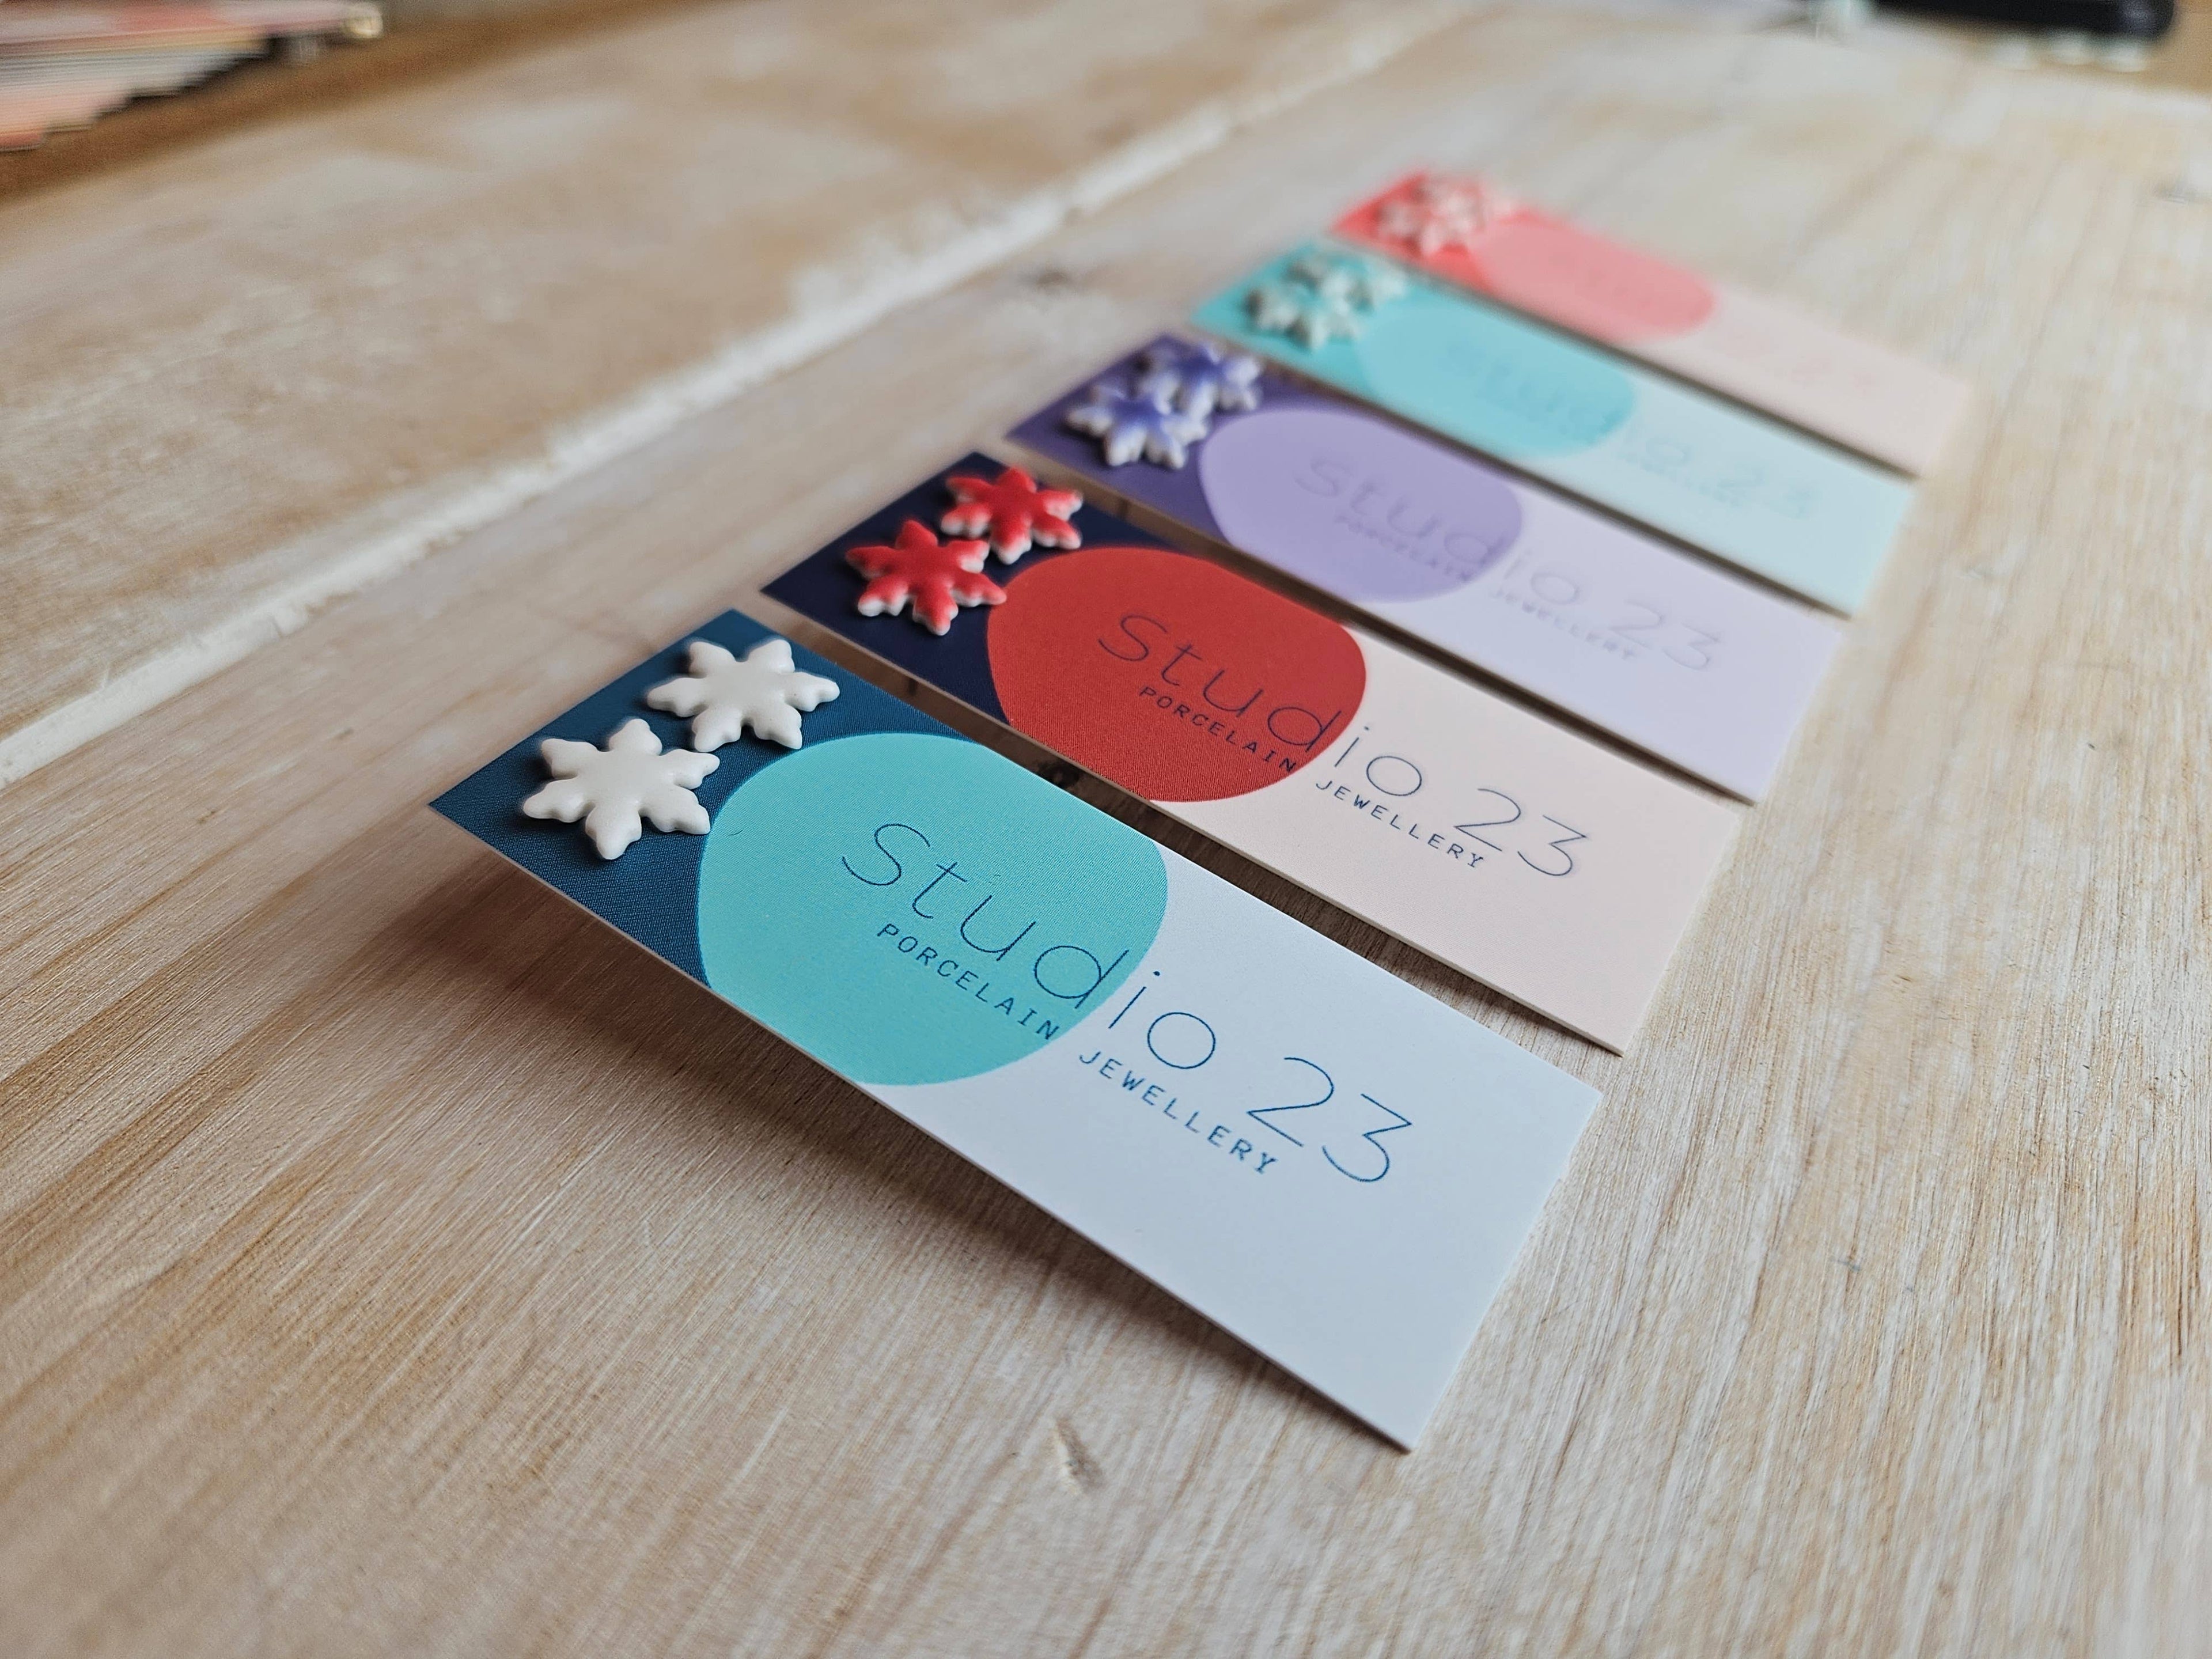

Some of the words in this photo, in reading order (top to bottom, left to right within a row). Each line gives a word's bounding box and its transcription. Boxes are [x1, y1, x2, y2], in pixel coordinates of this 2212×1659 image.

[1294, 455, 1581, 605] Studio
[1609, 598, 1721, 671] 23
[1098, 613, 1422, 796] Studio
[1453, 788, 1588, 876] 23
[1139, 687, 1297, 773] PORCELAIN
[1316, 779, 1486, 869] JEWELLERY
[842, 824, 1215, 1069] Studio
[1247, 1057, 1412, 1183] 23
[877, 923, 1060, 1040] PORCELAIN
[1078, 1052, 1279, 1175] JEWELLERY
